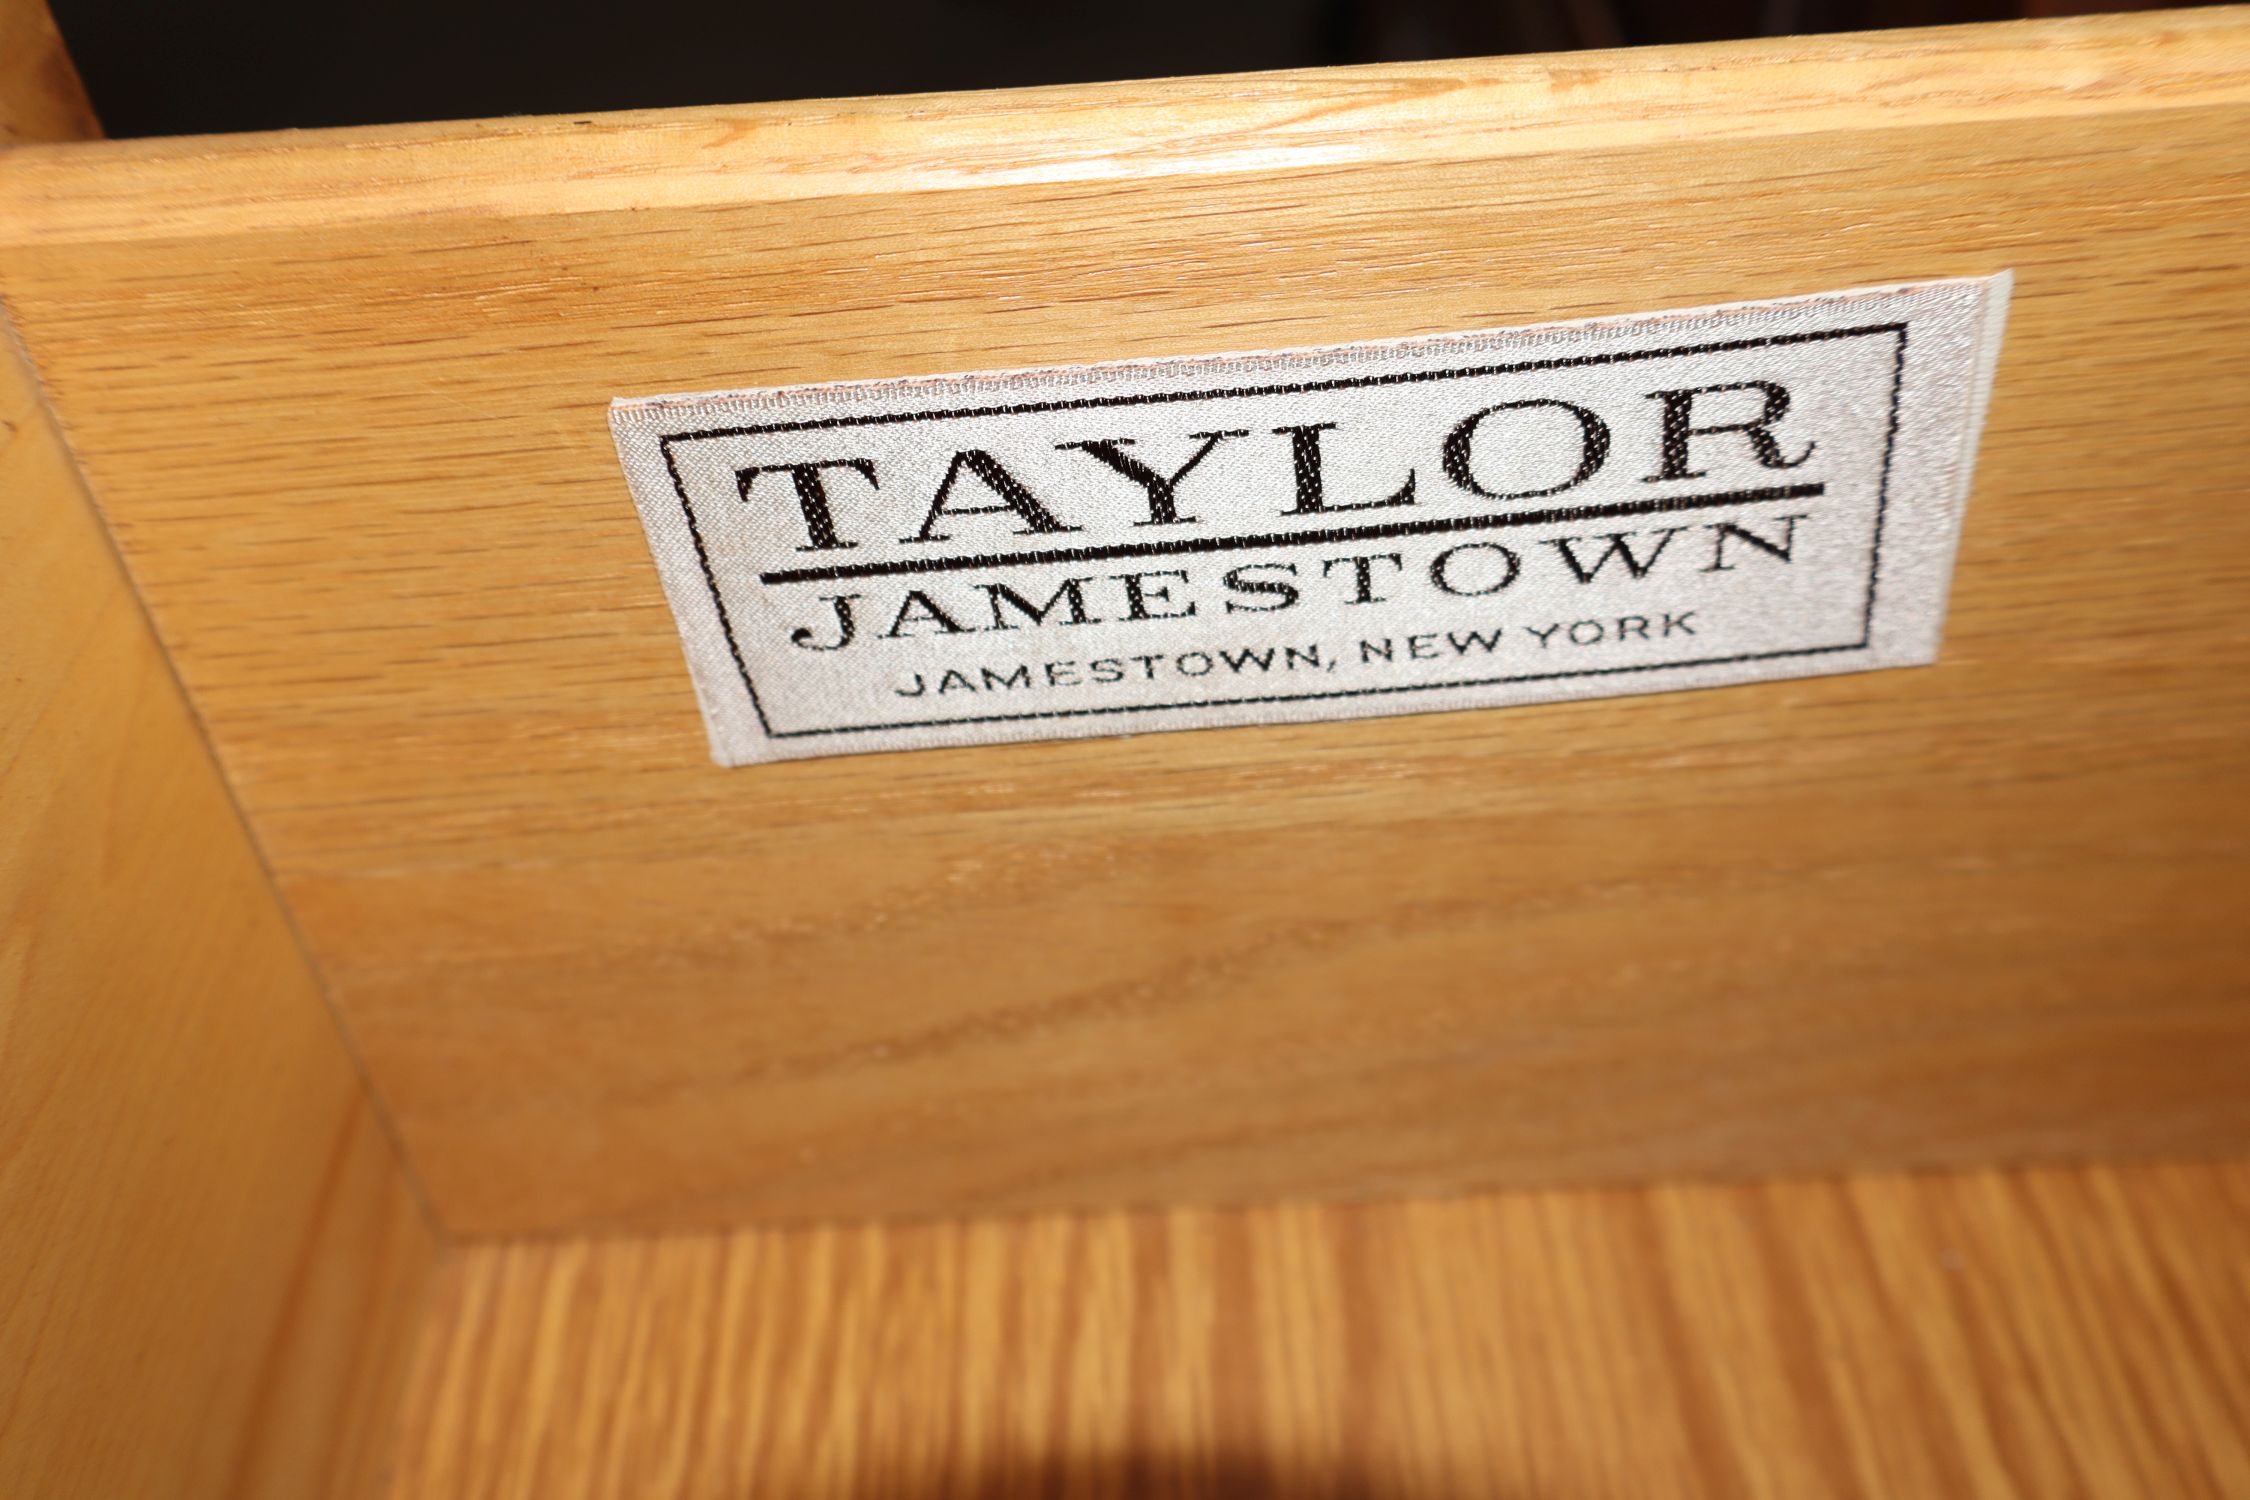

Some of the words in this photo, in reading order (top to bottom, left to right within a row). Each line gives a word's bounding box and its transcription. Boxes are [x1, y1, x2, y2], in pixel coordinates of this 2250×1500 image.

[736, 379, 1817, 552] TAYLOR
[790, 514, 1811, 651] JAMESTOWN
[894, 643, 1337, 698] JAMESTOWN,
[1361, 627, 1502, 663] NEW
[1526, 611, 1698, 648] YORK
